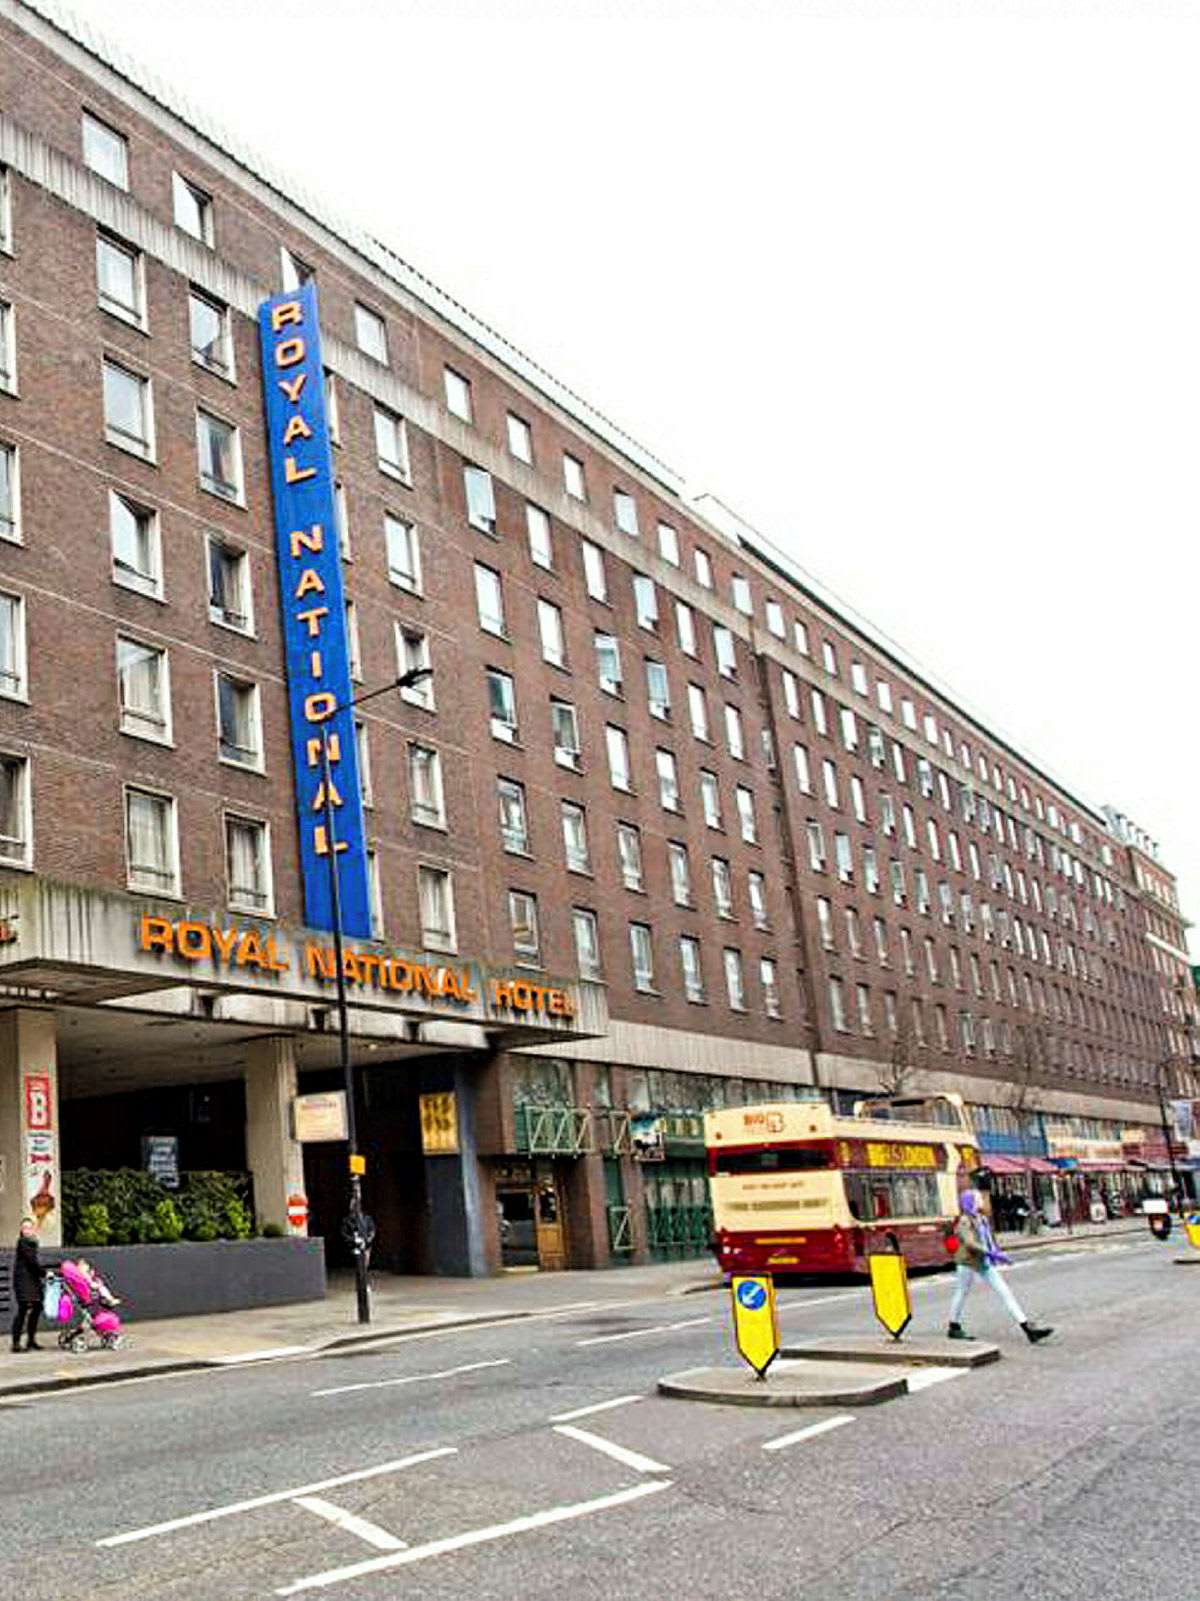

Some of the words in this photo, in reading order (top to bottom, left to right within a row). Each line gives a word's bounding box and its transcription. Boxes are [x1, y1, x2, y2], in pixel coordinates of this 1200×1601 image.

[271, 302, 316, 483] ROYAL
[289, 524, 348, 854] NATIONAL
[141, 911, 290, 971] ROYAL
[305, 940, 479, 1001] NATIONAL
[493, 977, 577, 1017] HOTEL
